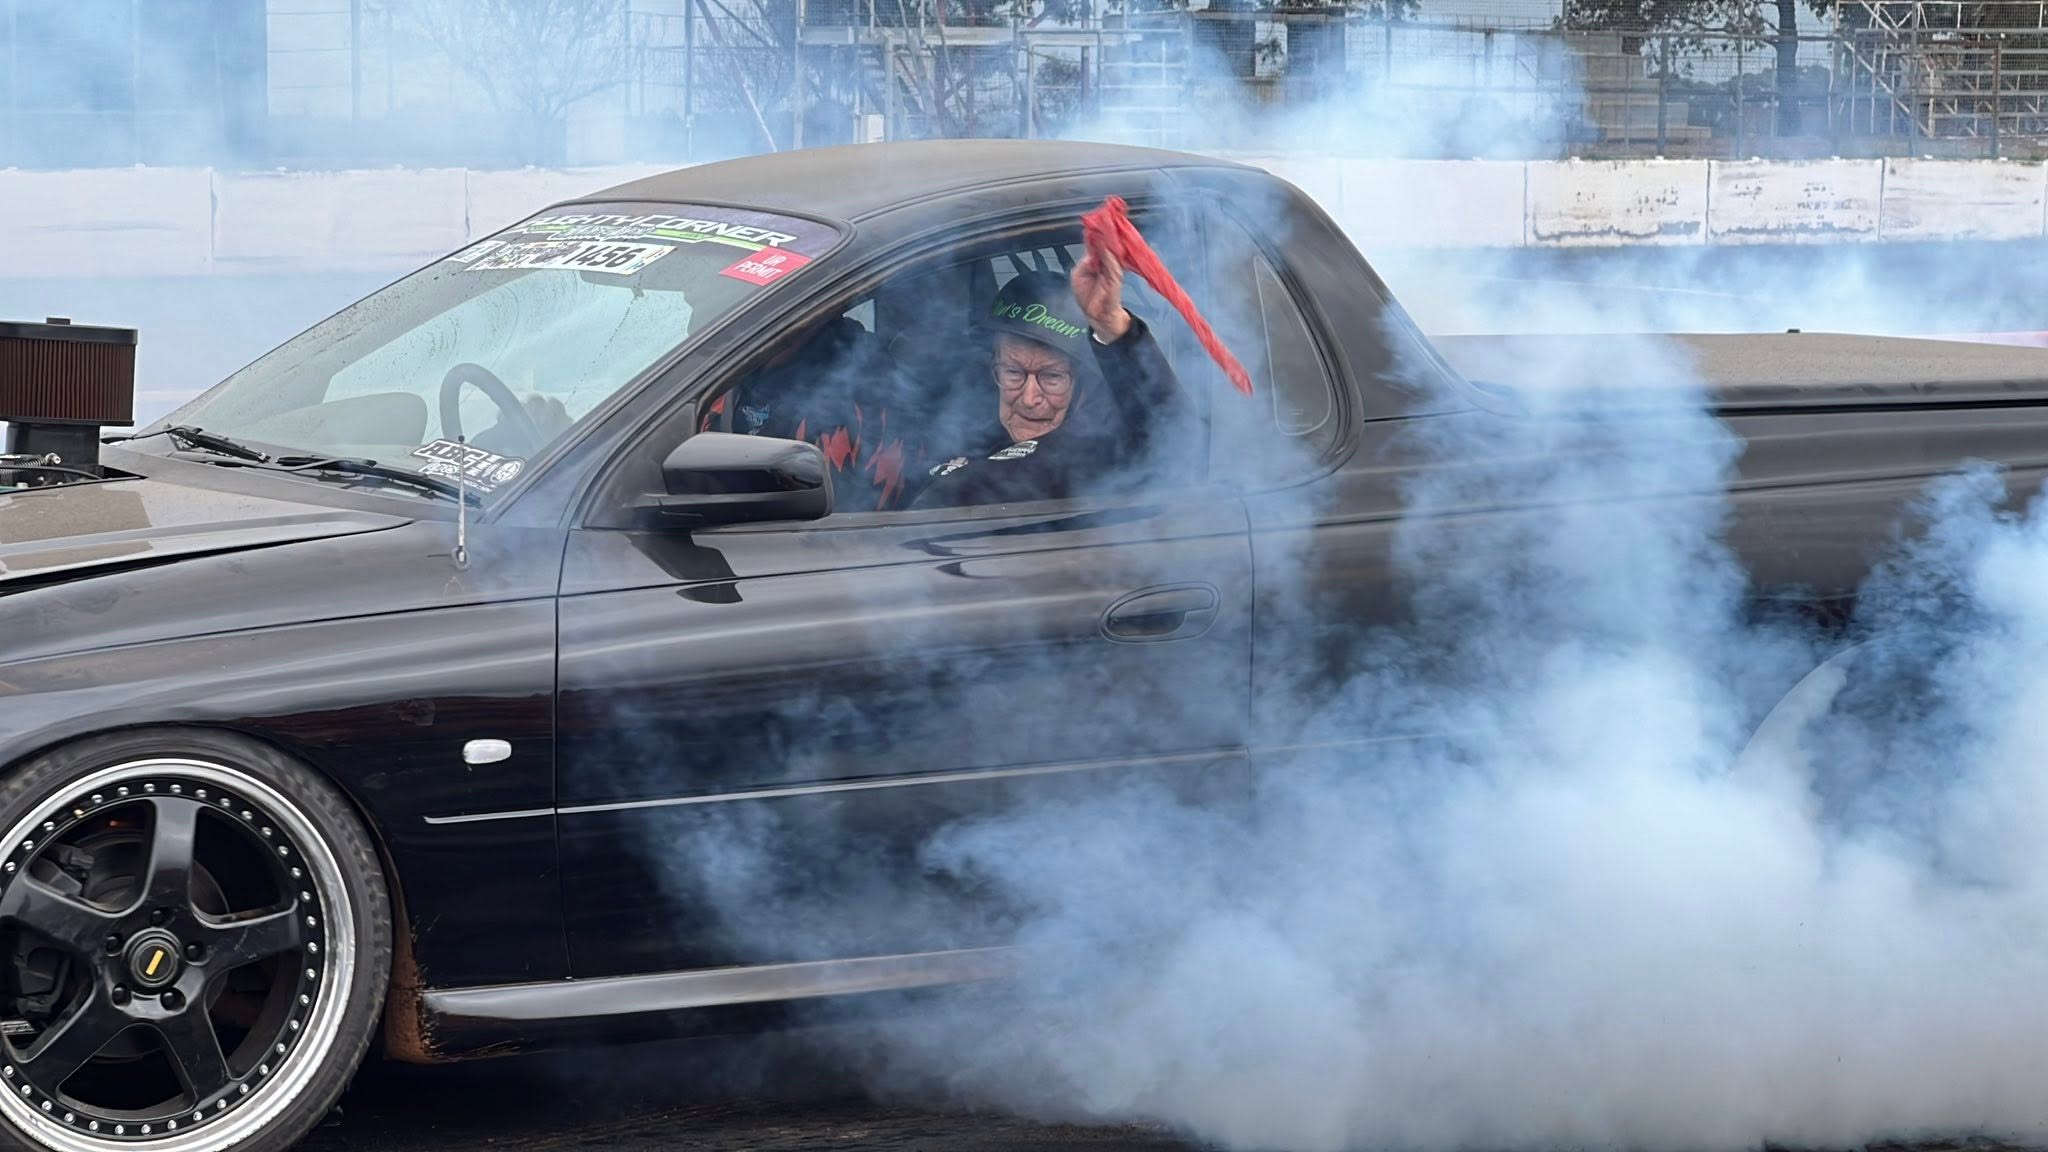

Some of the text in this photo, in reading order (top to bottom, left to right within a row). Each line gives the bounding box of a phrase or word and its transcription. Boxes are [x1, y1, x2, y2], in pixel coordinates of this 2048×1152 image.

[562, 244, 638, 268] 1456
[735, 260, 783, 279] PERMIT
[1022, 303, 1081, 338] Dream
